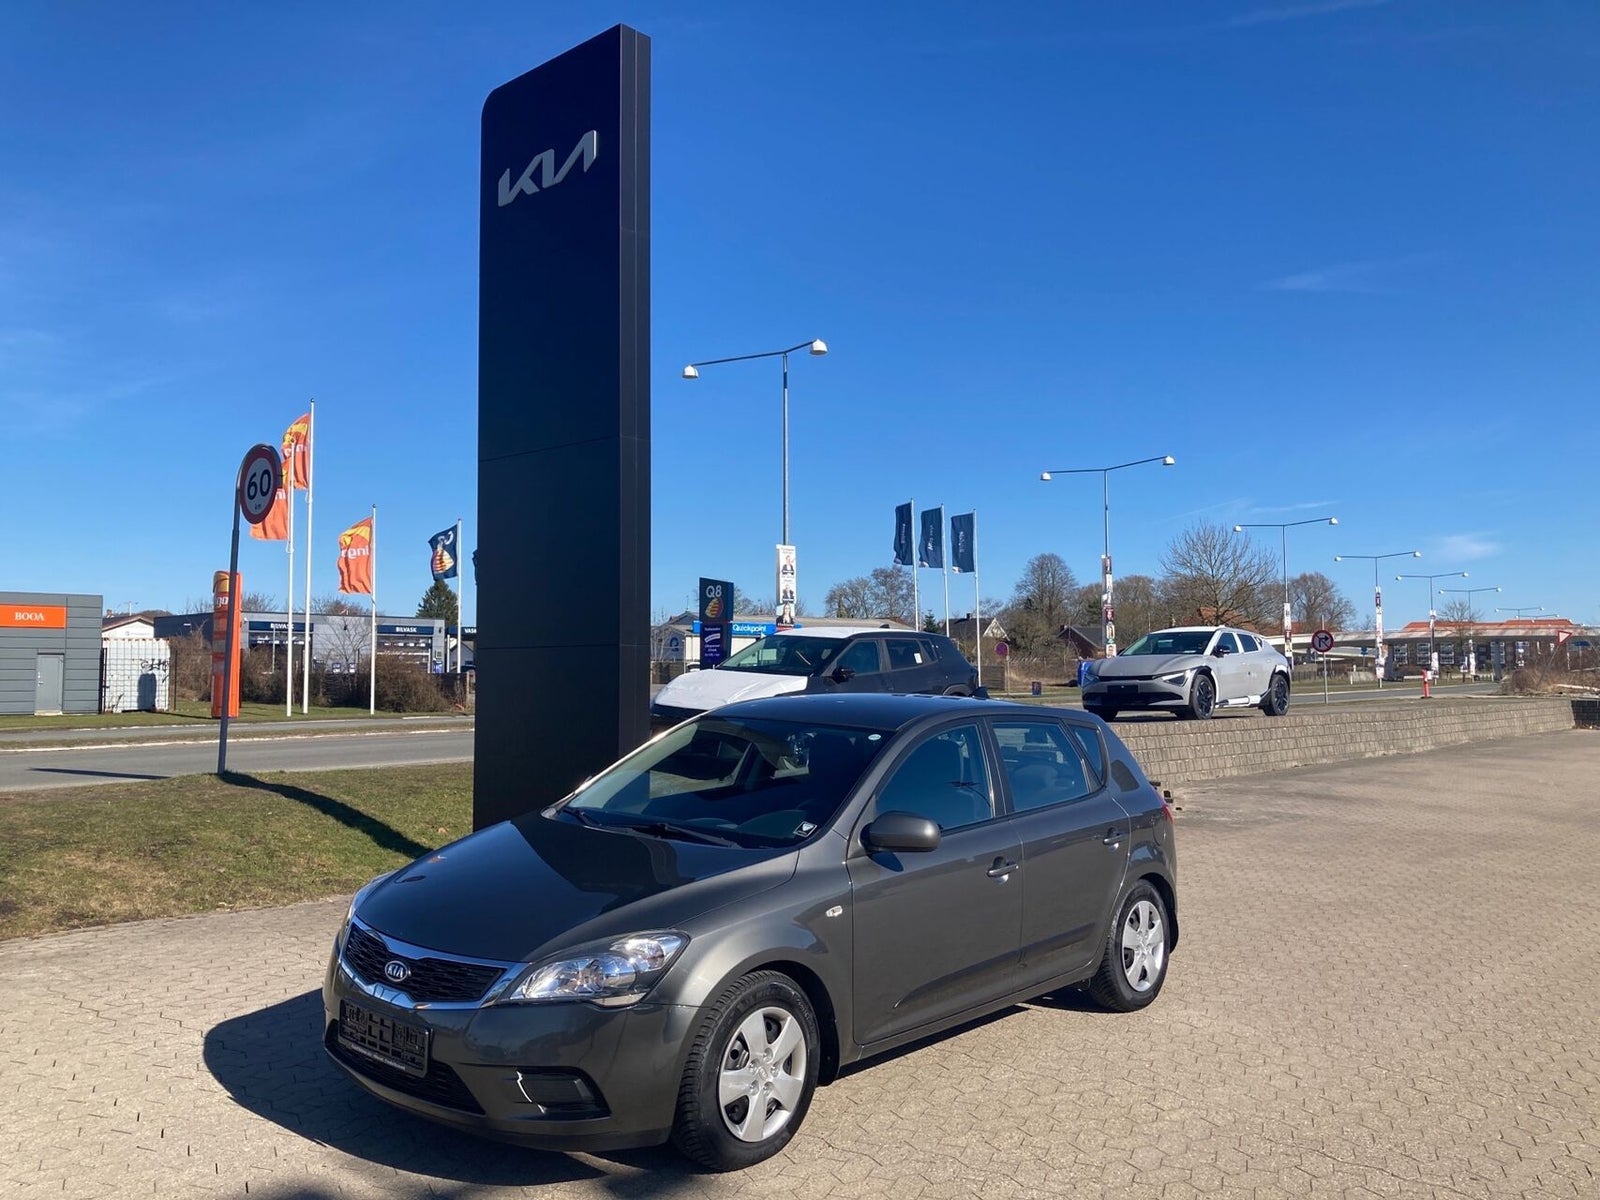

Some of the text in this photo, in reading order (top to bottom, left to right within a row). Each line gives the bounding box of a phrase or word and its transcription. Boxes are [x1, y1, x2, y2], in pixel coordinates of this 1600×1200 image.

[498, 129, 597, 207] KIA
[247, 468, 272, 500] 60
[705, 584, 722, 598] Q8
[15, 611, 45, 622] BOOA
[732, 623, 767, 634] Quickpoint
[387, 964, 404, 978] KIA
